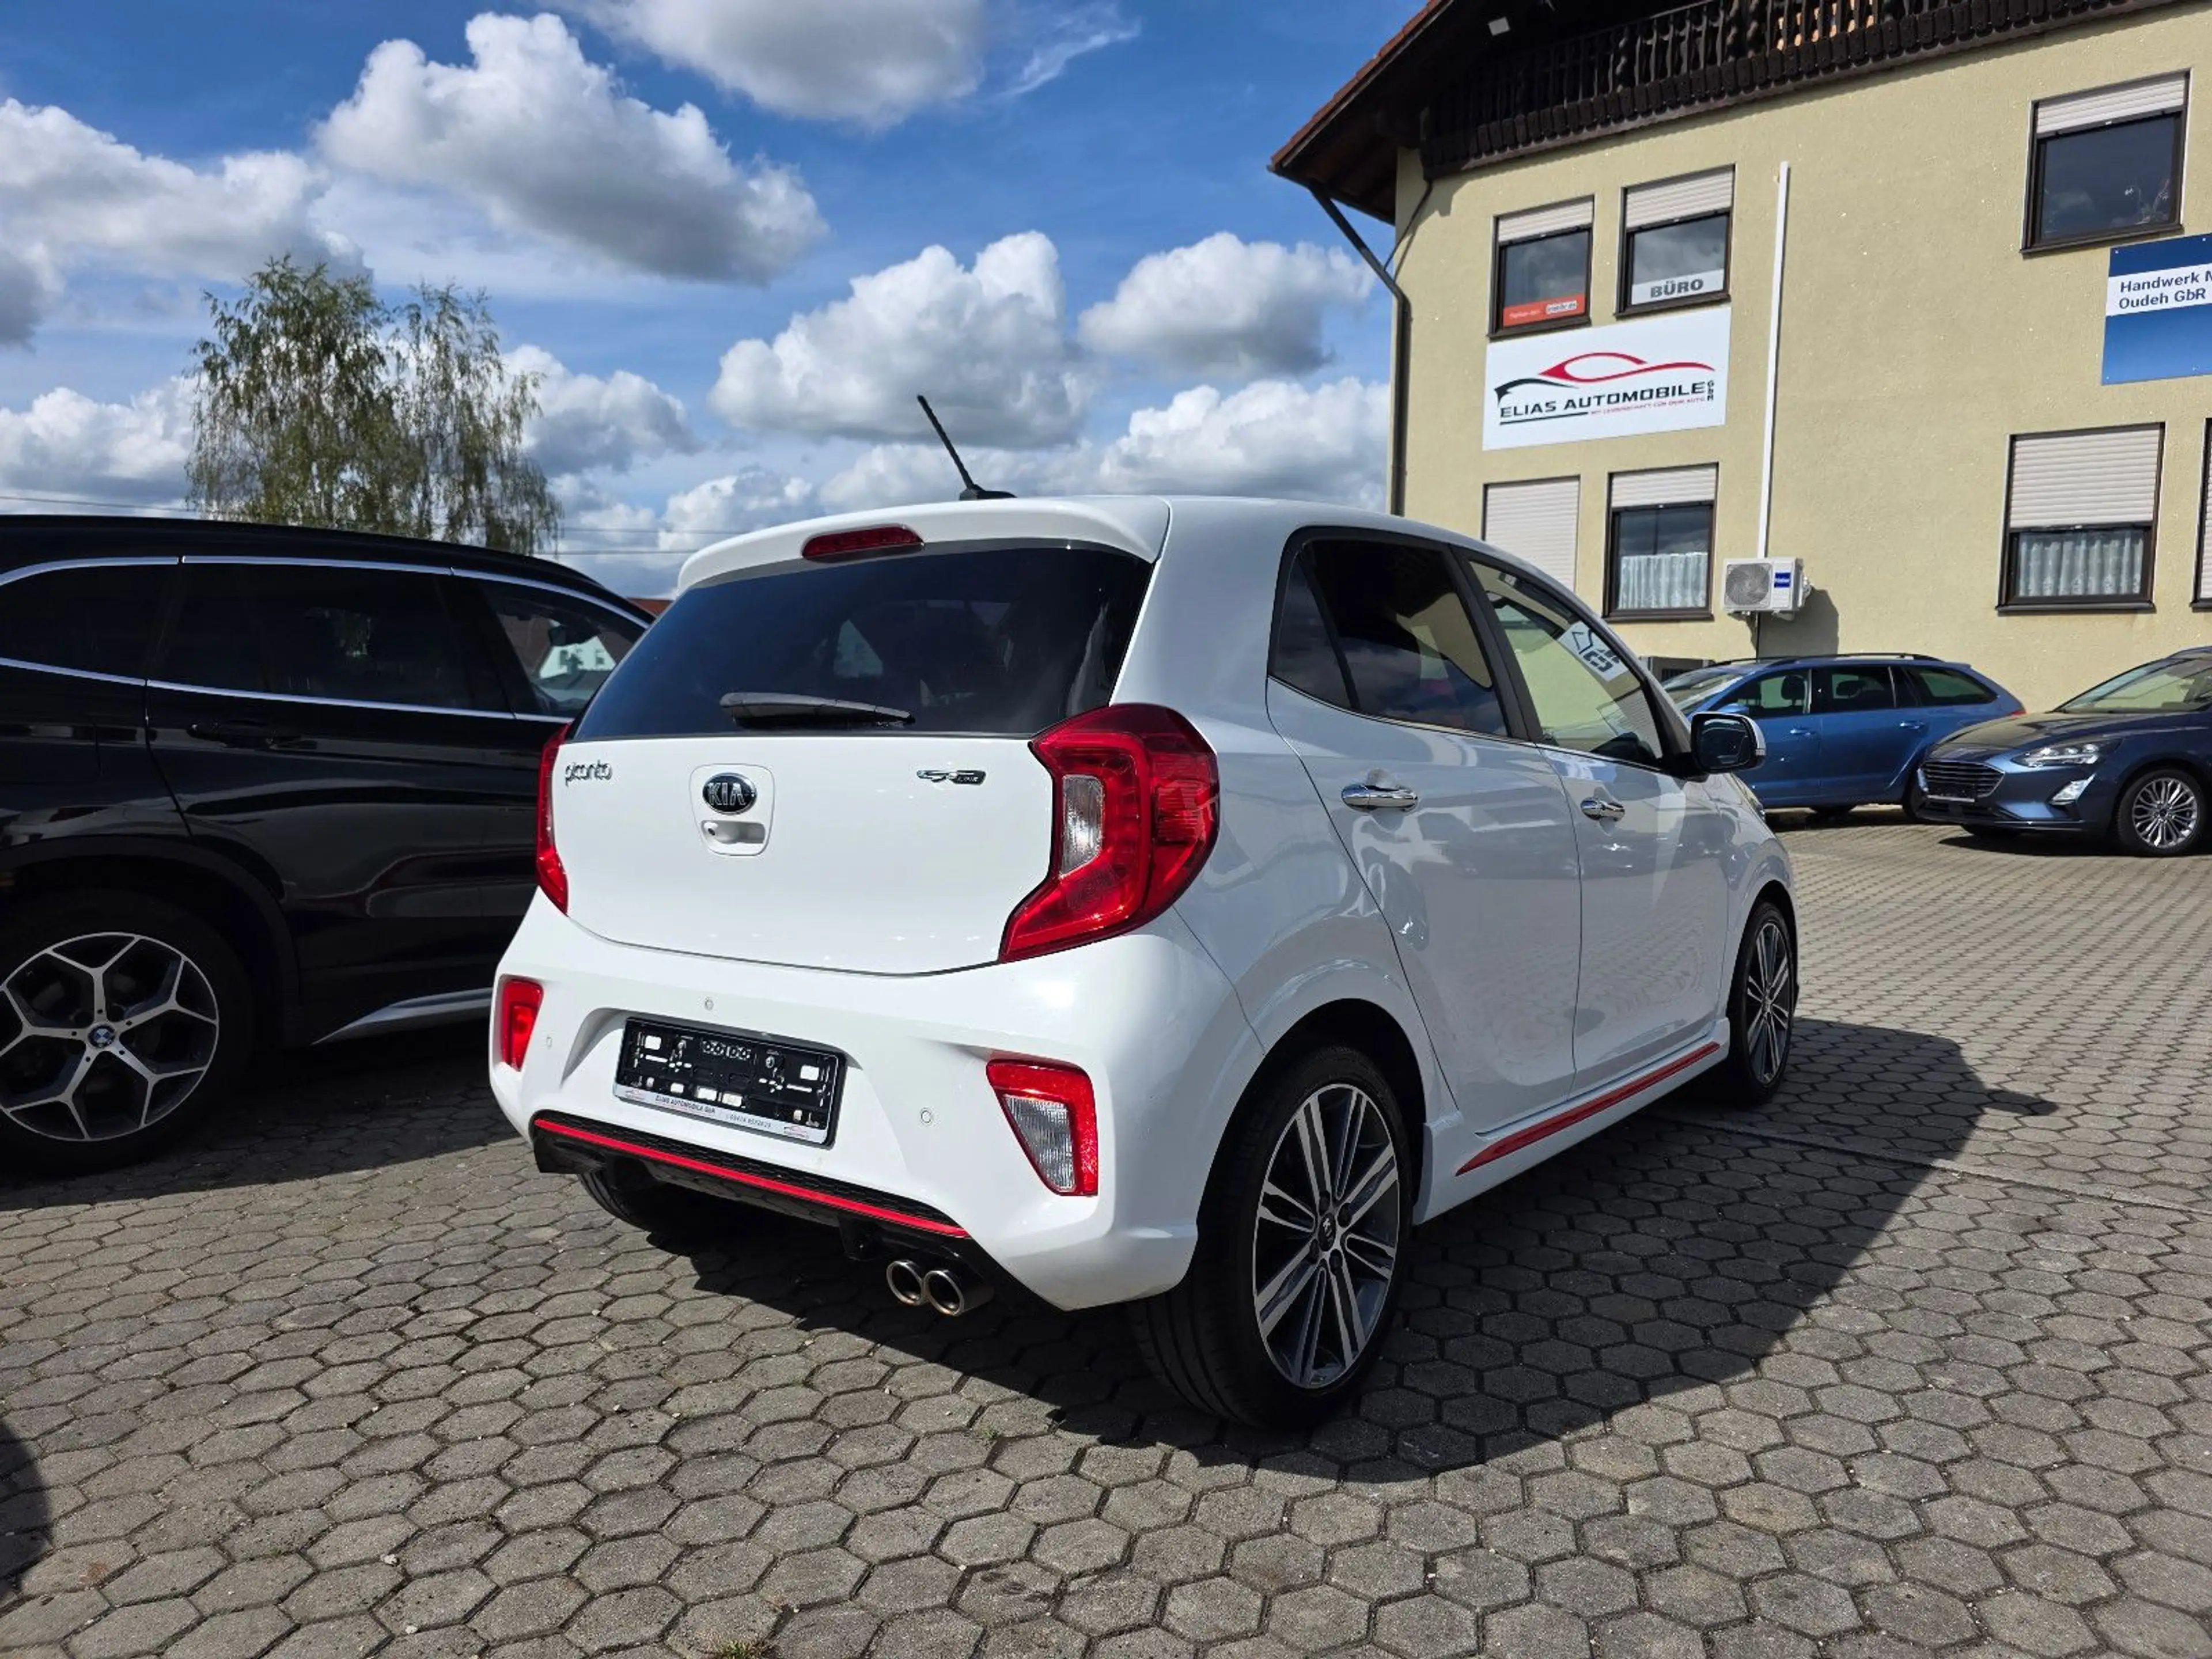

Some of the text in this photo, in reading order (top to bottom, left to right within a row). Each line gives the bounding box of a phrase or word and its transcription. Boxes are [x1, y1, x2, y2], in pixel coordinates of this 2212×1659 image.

[1650, 279, 1704, 298] BÜRO
[2120, 272, 2200, 293] Handwerk
[2119, 287, 2206, 309] Oudeh GbR
[1500, 401, 1556, 418] ELIAS
[1564, 381, 1706, 410] AUTOMOBILE
[565, 759, 613, 787] picanto
[707, 782, 747, 805] KIA
